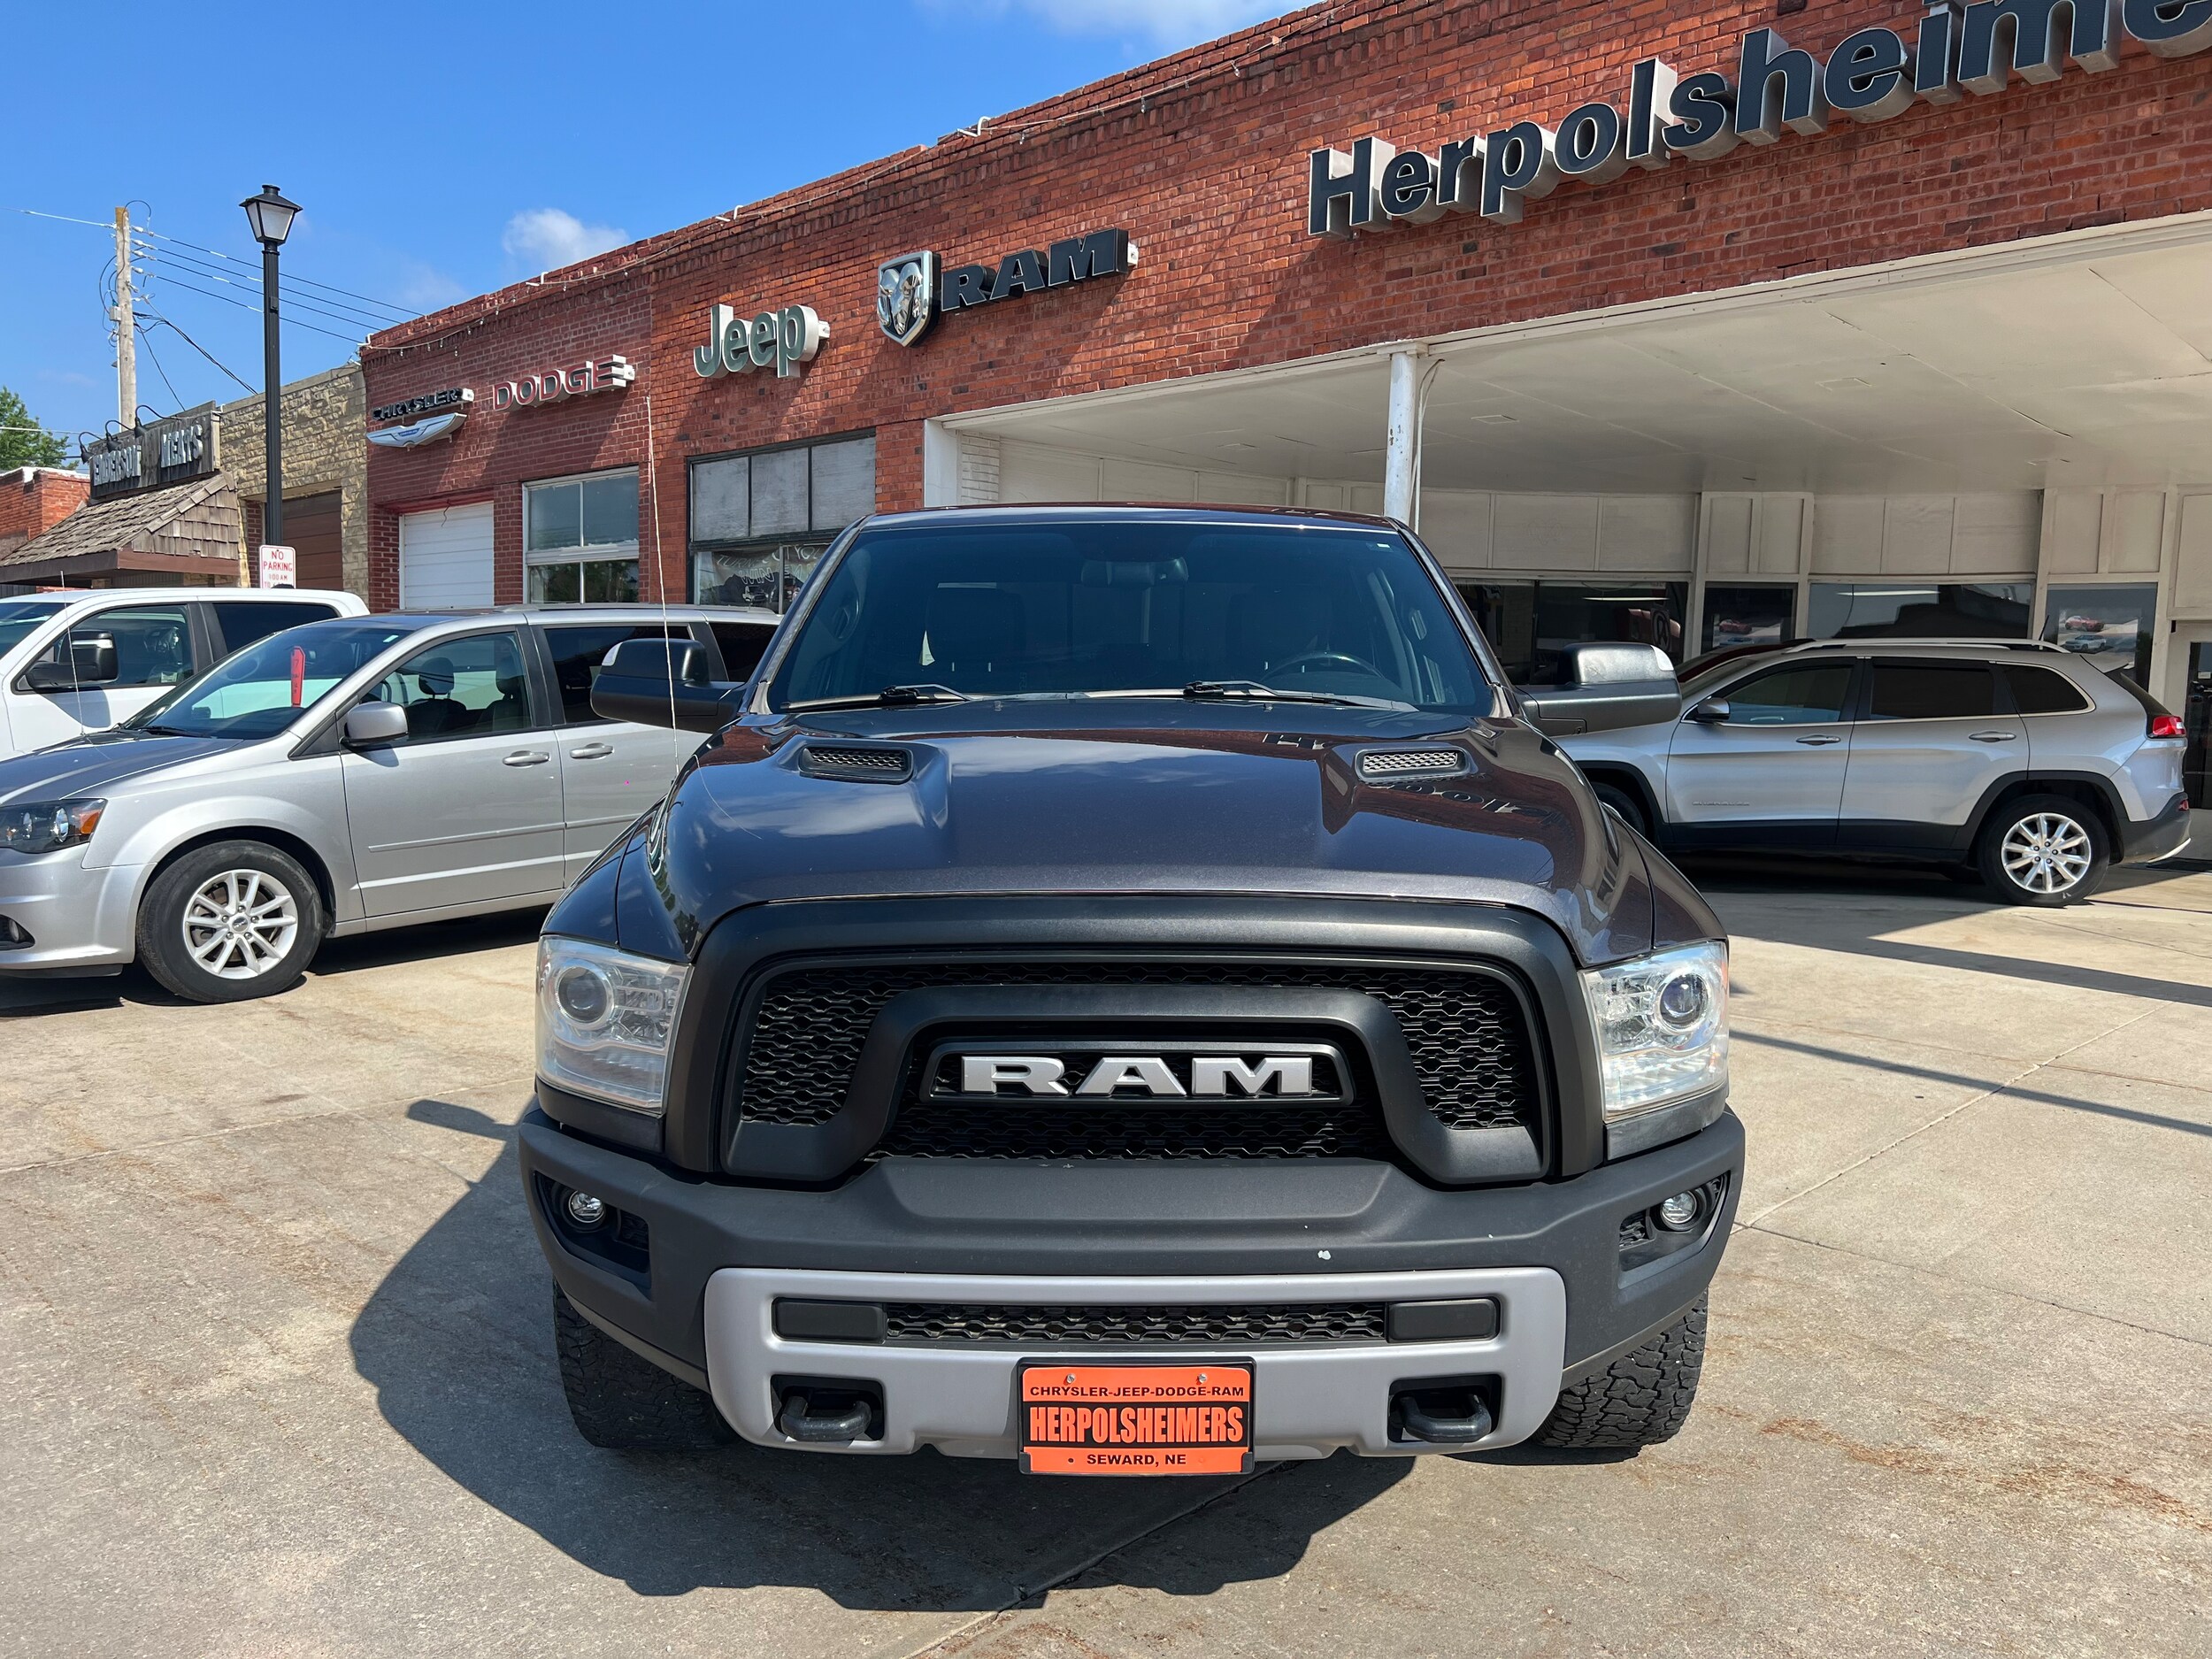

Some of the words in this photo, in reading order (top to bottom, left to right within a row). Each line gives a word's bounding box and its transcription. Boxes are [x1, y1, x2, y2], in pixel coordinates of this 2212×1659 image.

[941, 227, 1122, 312] RAM
[693, 303, 812, 379] Jeep
[492, 354, 621, 411] DODGE
[372, 388, 461, 421] CHRYSLER
[160, 424, 204, 469] MEATS
[263, 561, 293, 572] PARKING
[271, 550, 284, 561] NO
[738, 566, 775, 585] WIN
[961, 1056, 1313, 1097] RAM
[1029, 1386, 1245, 1397] CHRYSLER-JEEP-DODGE-RAM
[1029, 1405, 1244, 1444] HERPOLSHEIMERS
[1086, 1454, 1160, 1468] SEWARD,
[1164, 1454, 1187, 1465] NE
